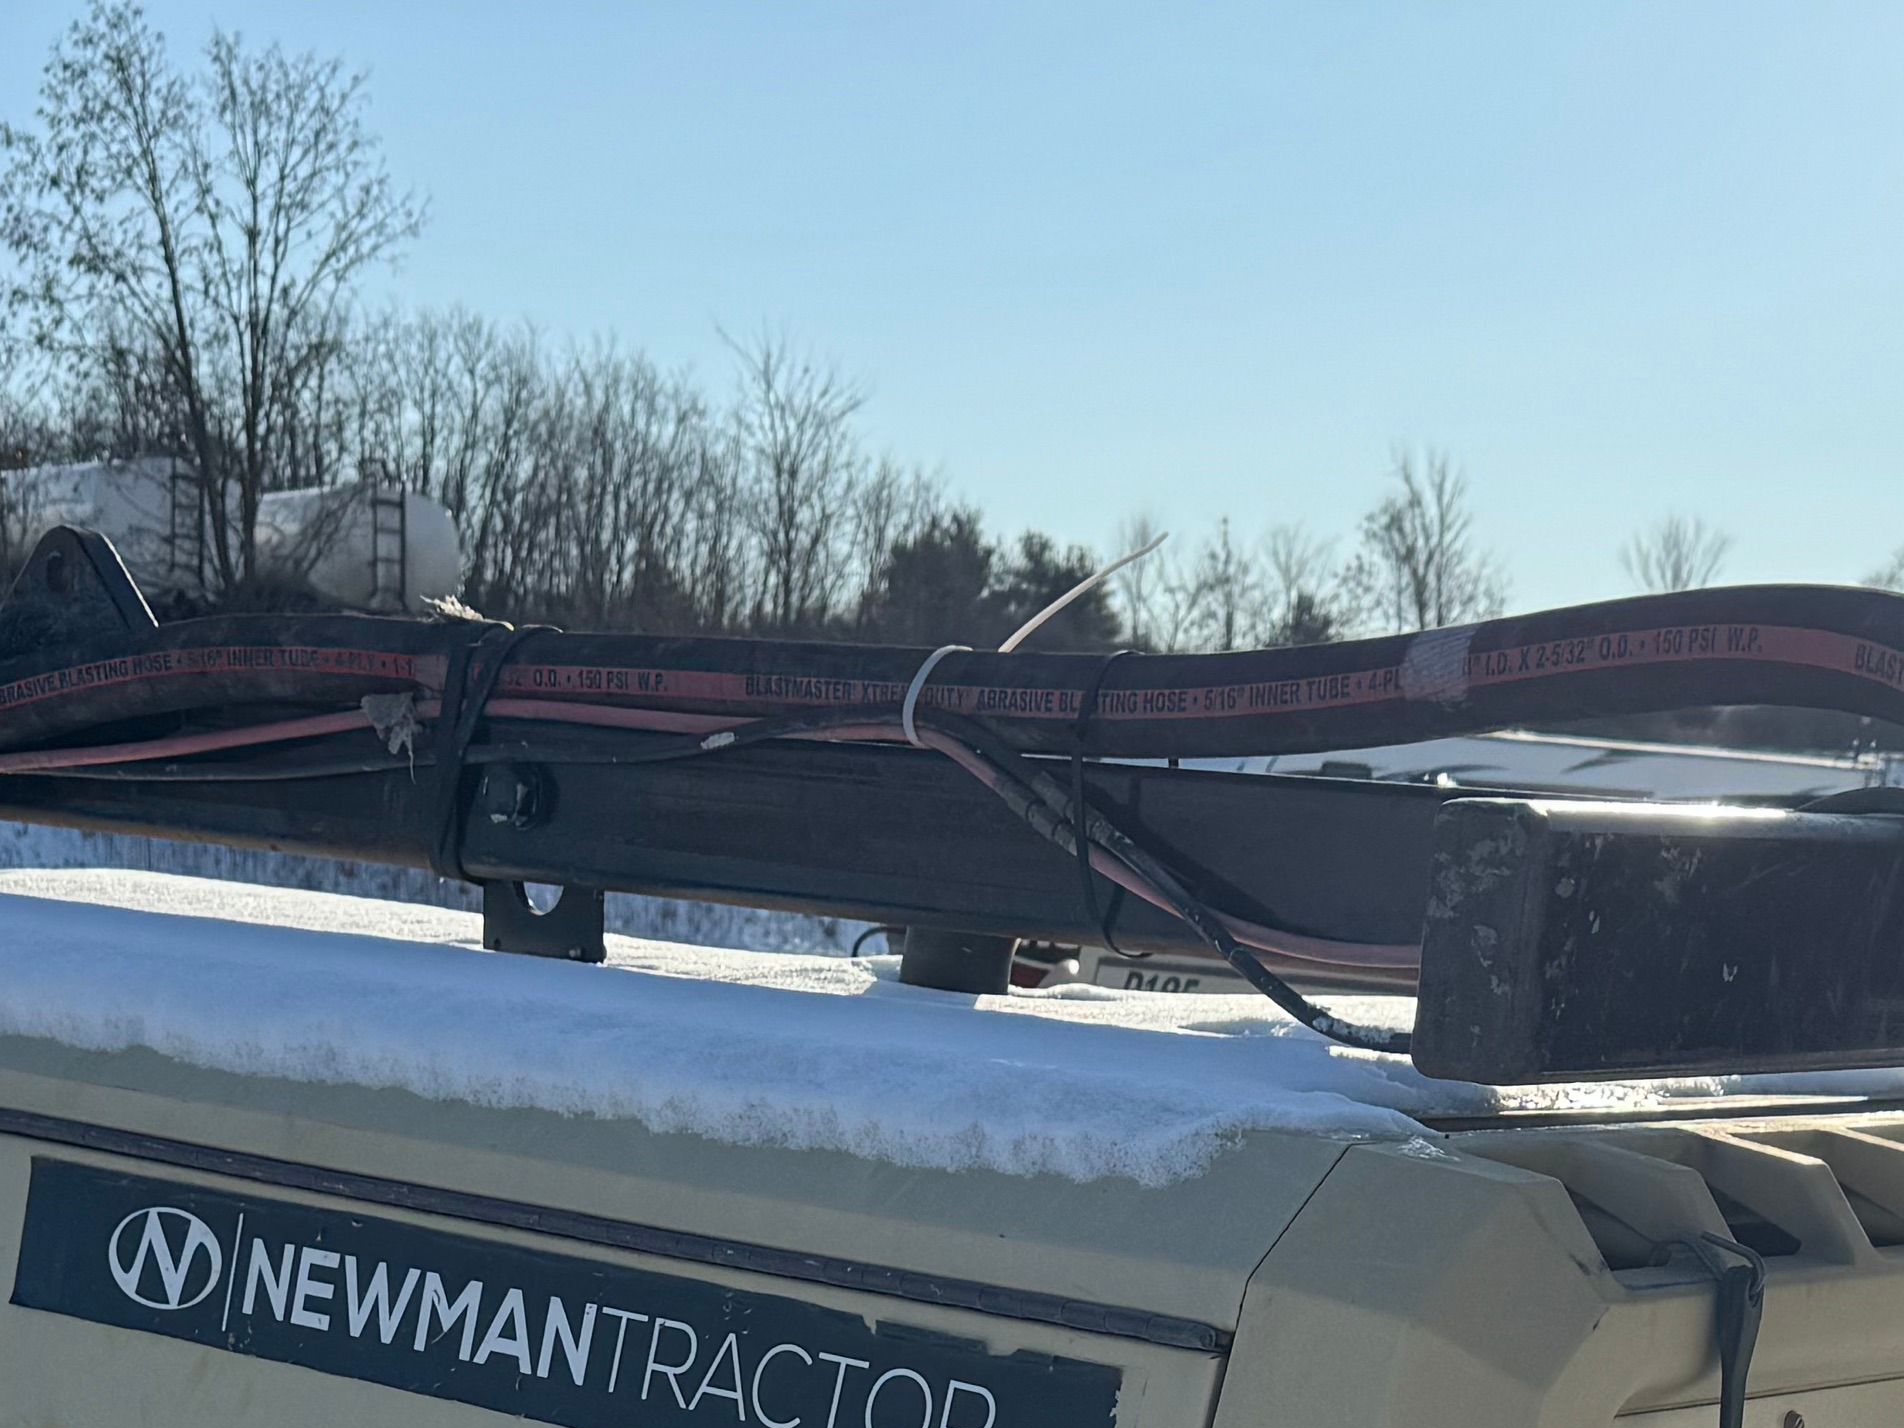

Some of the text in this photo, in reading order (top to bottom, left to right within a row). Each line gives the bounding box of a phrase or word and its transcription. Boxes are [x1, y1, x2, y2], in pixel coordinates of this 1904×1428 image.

[59, 658, 129, 689] BLASTING
[132, 653, 173, 676] HOSE
[578, 669, 602, 689] 150
[606, 671, 630, 690] PSI
[976, 688, 1054, 713] ABRASIVE
[1059, 691, 1138, 714] BLTING
[1142, 690, 1188, 714] HOSE
[1249, 682, 1300, 708] INNER
[1307, 674, 1351, 702] TUBE
[1368, 667, 1403, 691] 4-PL
[1654, 630, 1683, 656] 150
[1688, 626, 1718, 652] PSI
